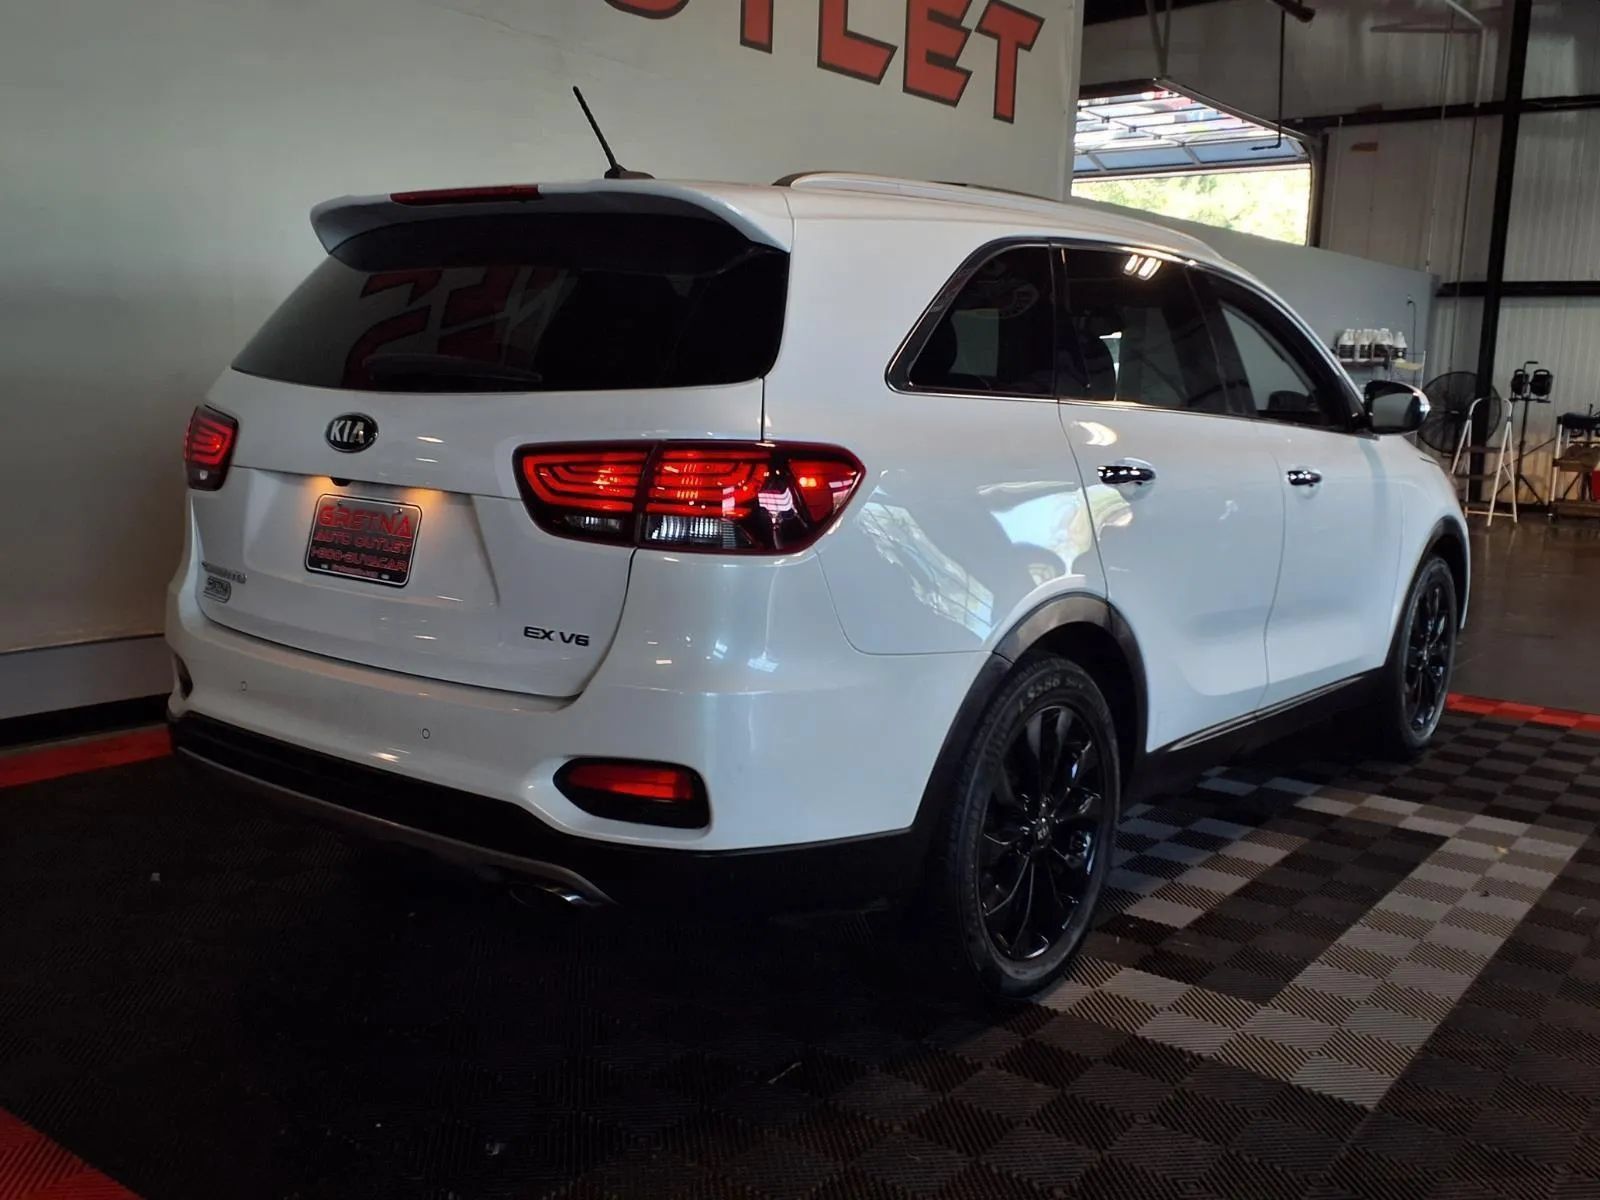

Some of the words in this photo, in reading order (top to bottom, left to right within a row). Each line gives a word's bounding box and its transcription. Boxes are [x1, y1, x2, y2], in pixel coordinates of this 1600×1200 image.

[330, 420, 365, 444] KIA
[319, 505, 413, 539] GRETNA
[354, 534, 413, 556] OUTLET
[523, 626, 555, 641] EX
[559, 631, 590, 647] V6
